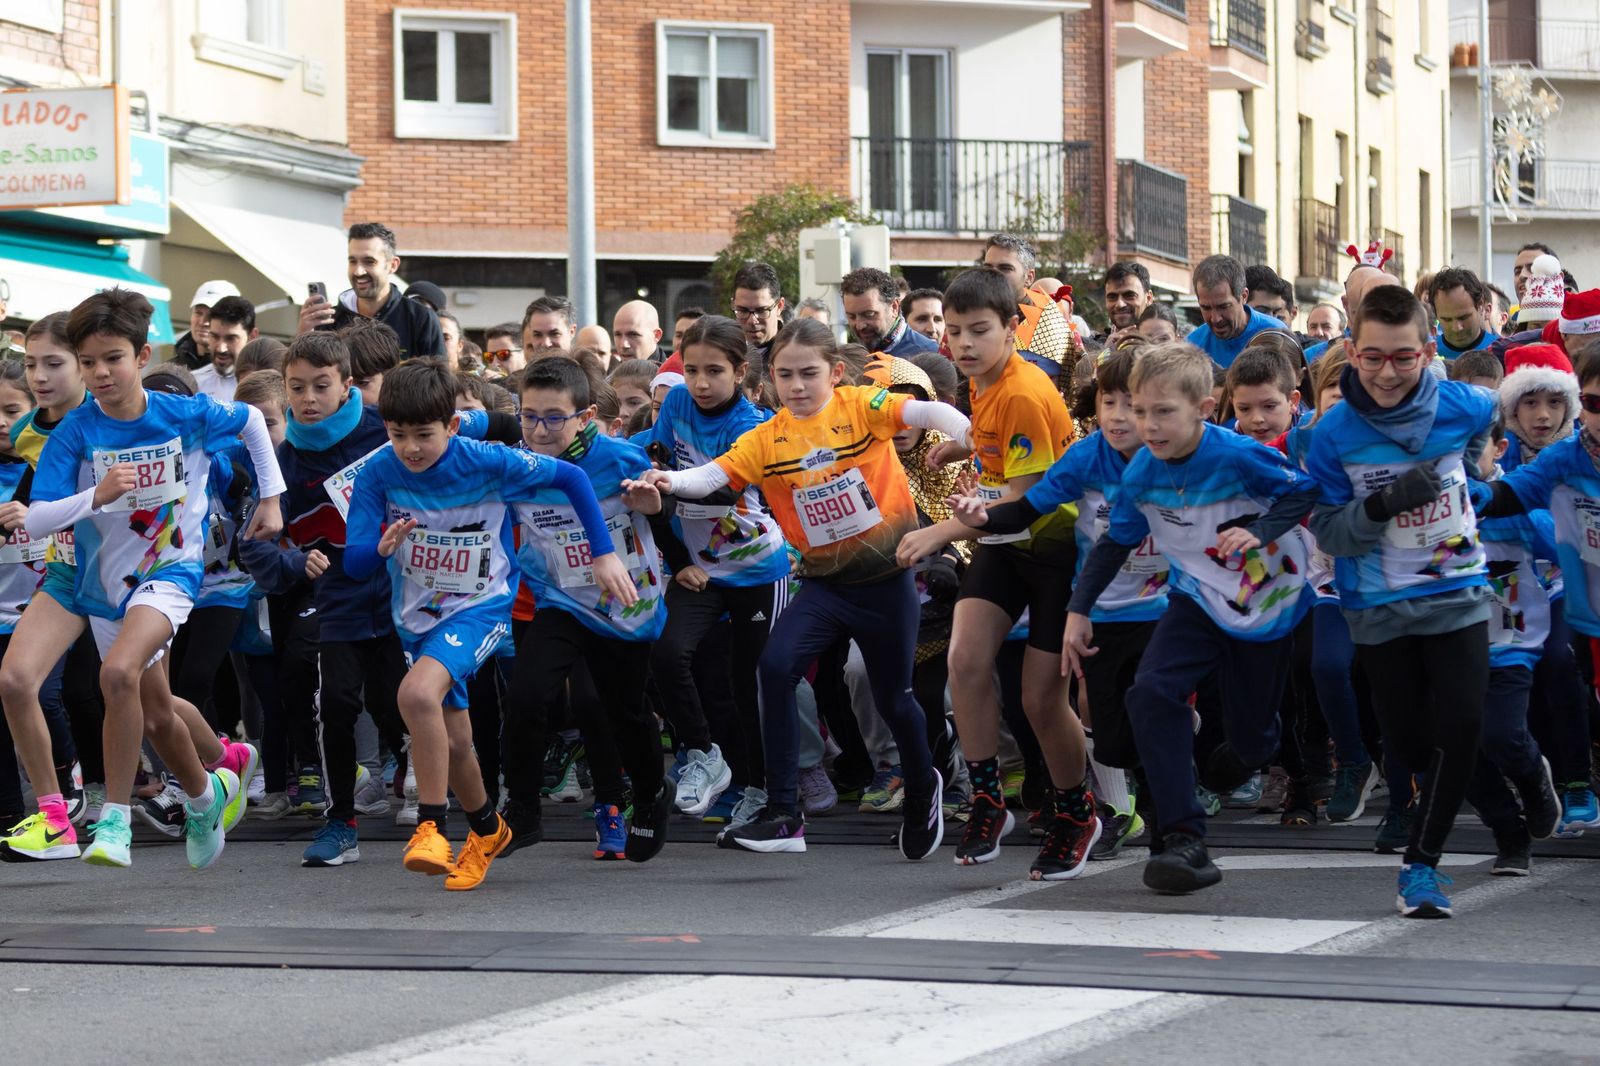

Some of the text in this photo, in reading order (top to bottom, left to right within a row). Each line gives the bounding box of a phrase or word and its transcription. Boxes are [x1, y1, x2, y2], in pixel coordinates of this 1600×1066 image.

[118, 446, 175, 463] SETEL
[807, 477, 856, 500] SETEL
[804, 492, 857, 527] 6990
[426, 535, 483, 546] SETEL
[410, 544, 471, 573] 6840
[631, 826, 654, 838] PUMA
